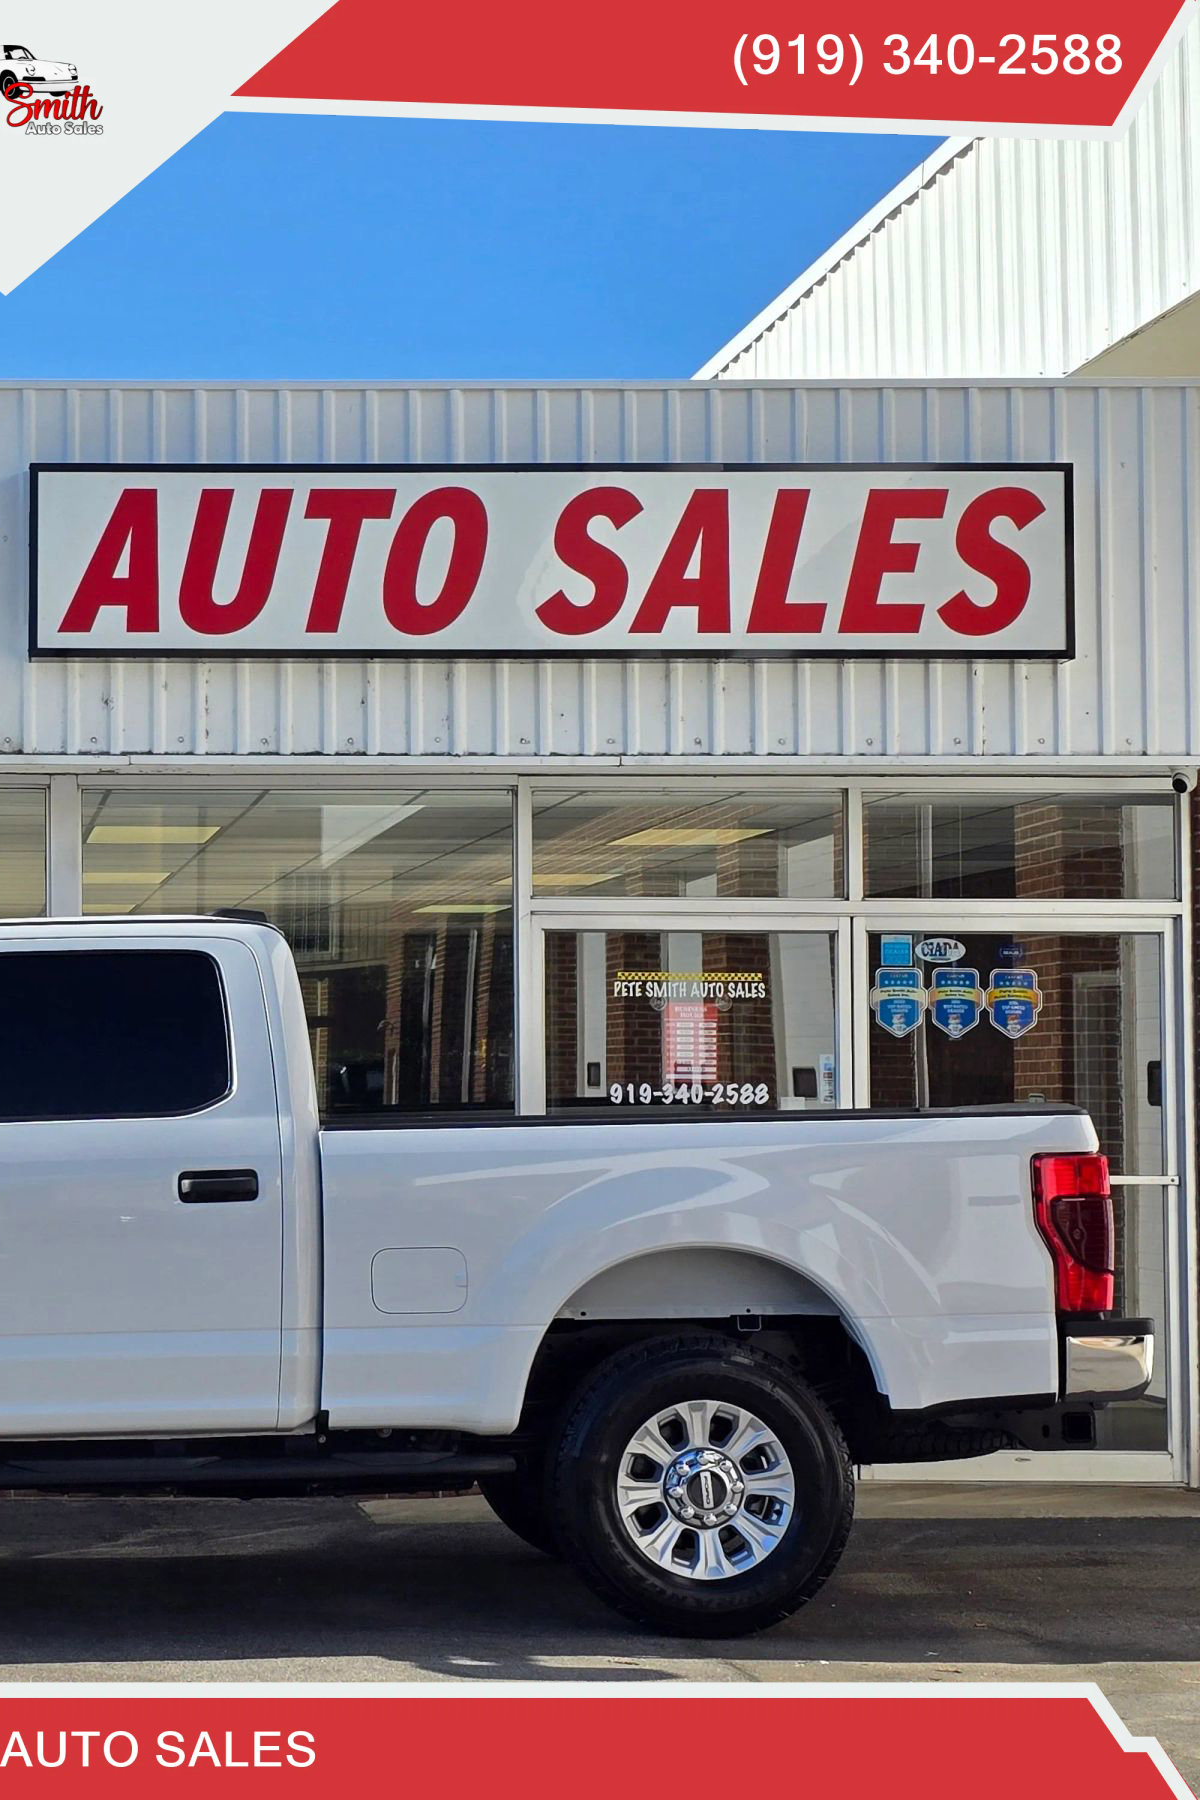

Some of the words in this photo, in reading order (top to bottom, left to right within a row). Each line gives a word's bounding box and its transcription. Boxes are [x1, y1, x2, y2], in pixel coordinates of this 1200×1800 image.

[58, 486, 490, 637] AUTO
[535, 486, 1047, 637] SALES
[614, 981, 643, 997] PETE
[645, 981, 687, 998] SMITH
[690, 982, 725, 998] AUTO
[727, 982, 766, 998] SALES
[609, 1083, 770, 1105] 919-340-2588
